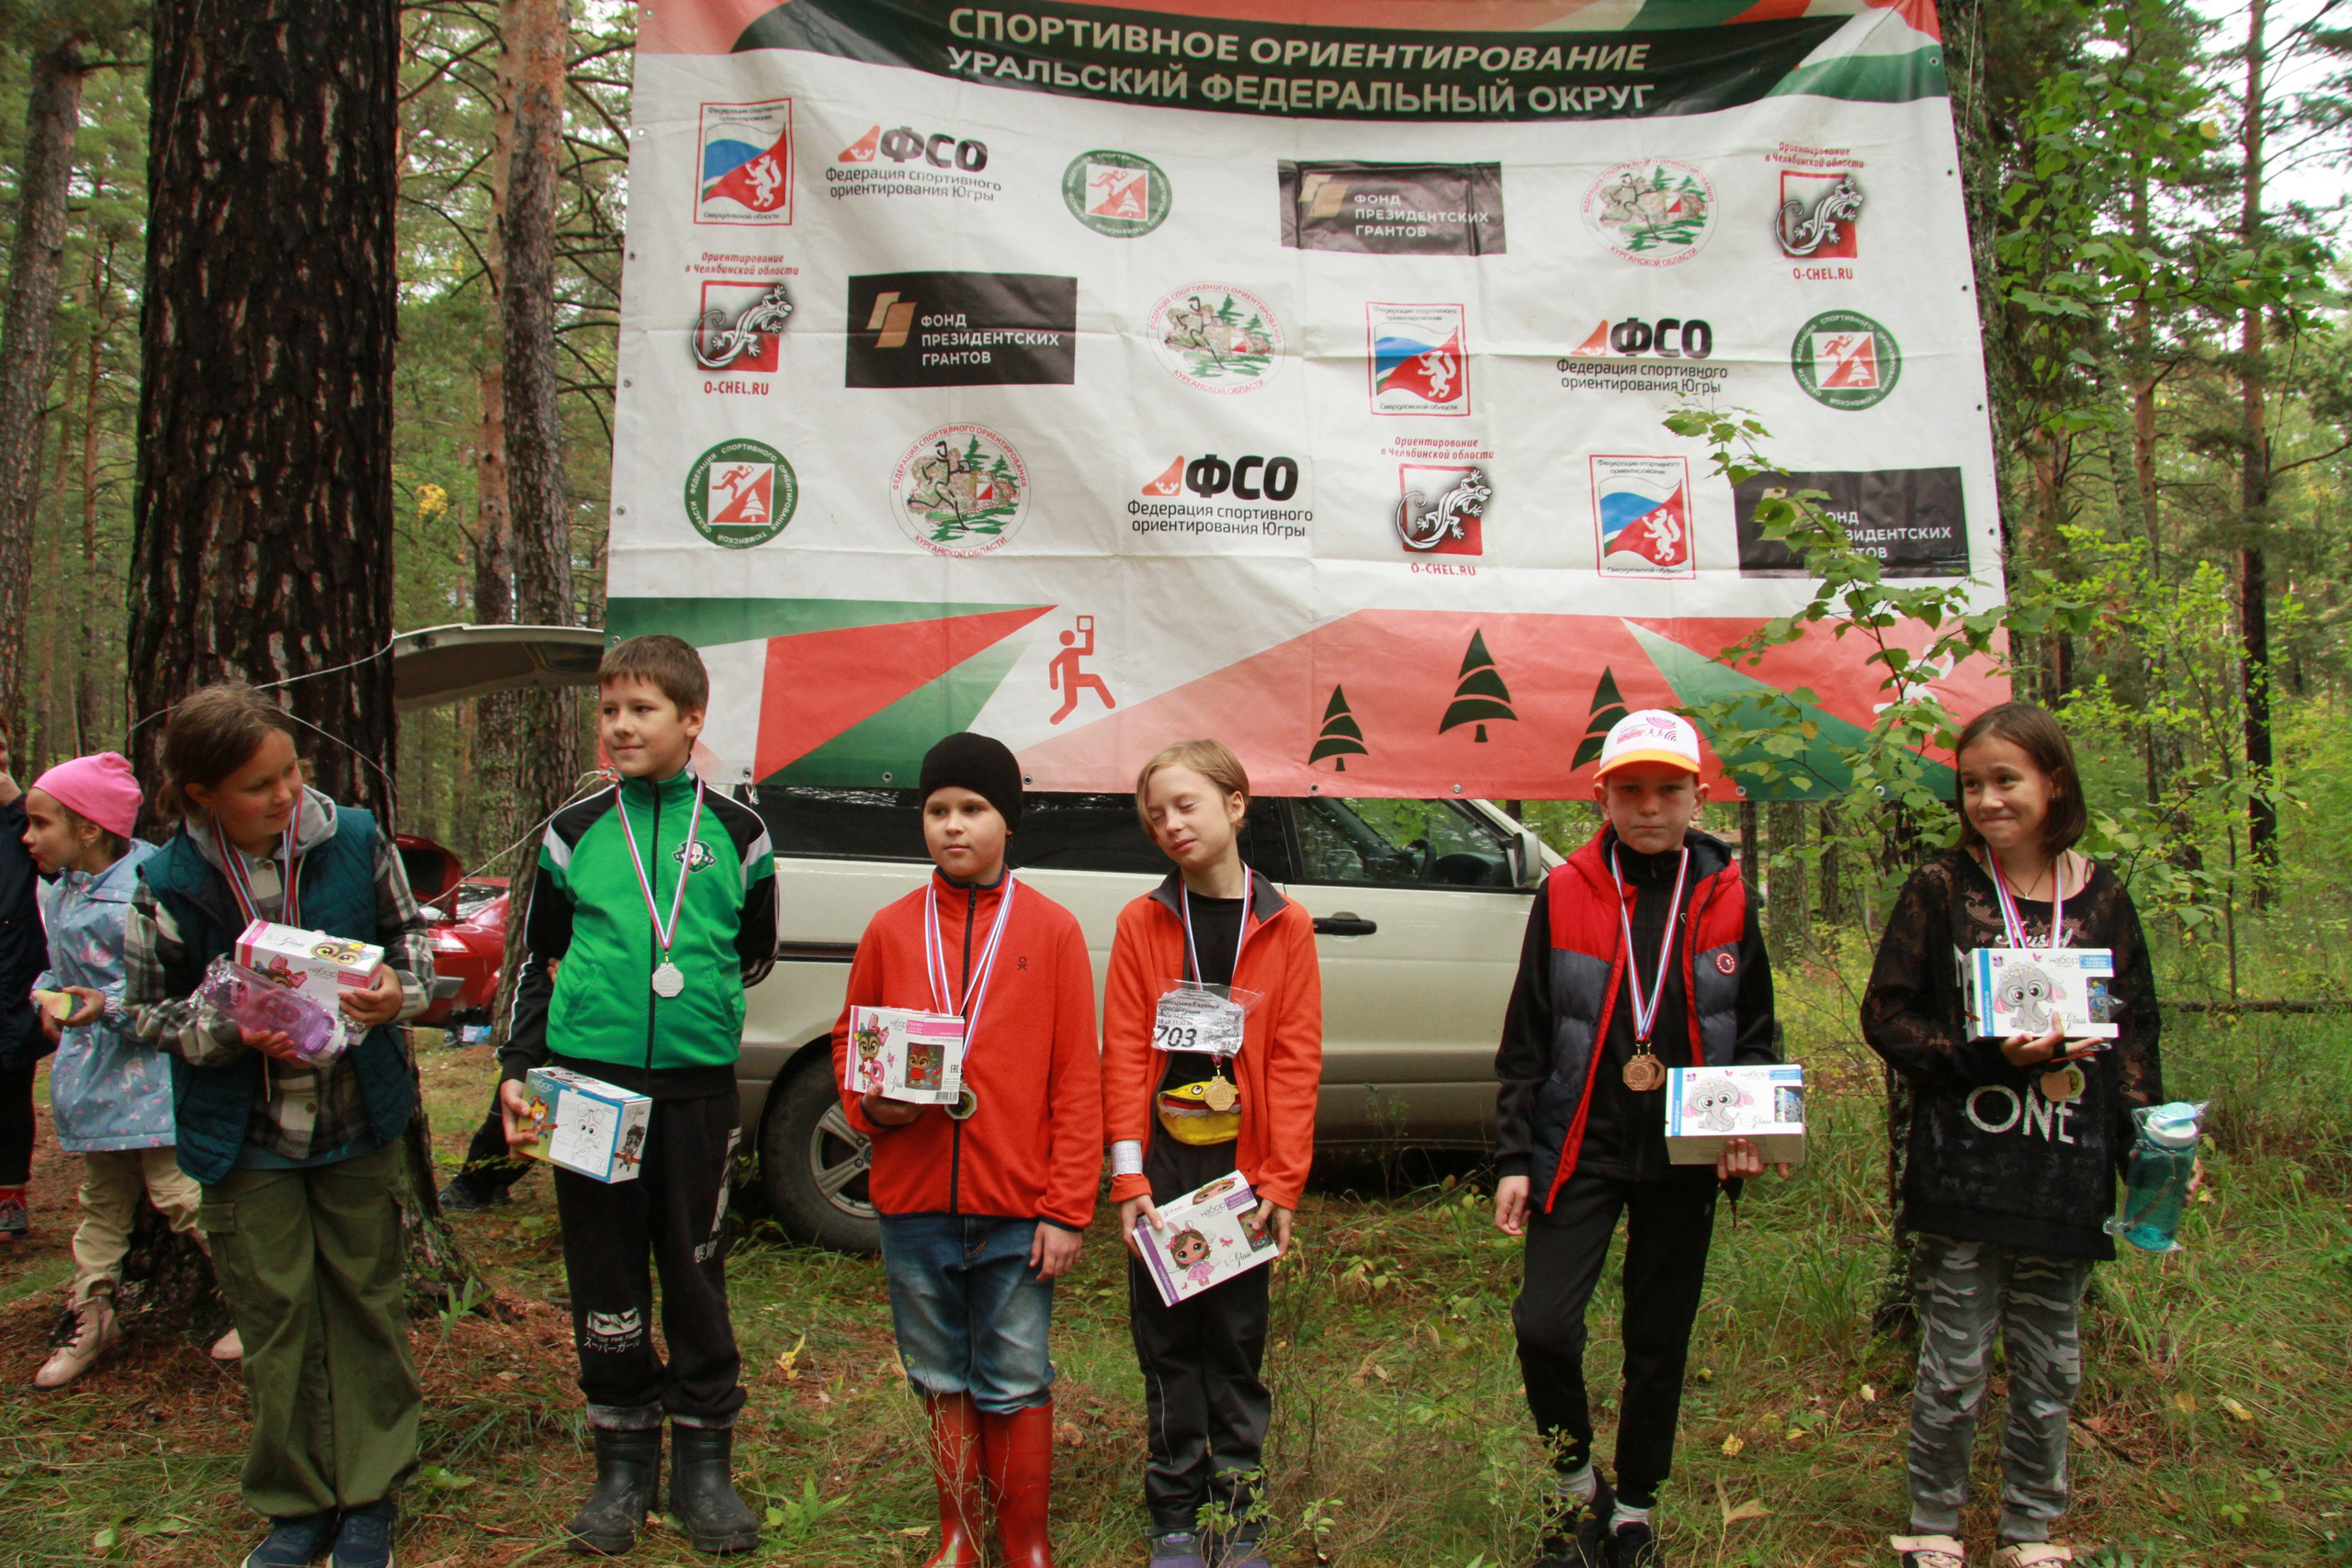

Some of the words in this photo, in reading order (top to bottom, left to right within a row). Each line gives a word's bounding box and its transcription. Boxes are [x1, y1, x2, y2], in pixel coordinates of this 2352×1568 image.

[949, 8, 1238, 62] СПОРТИВНОЕ
[1250, 38, 1651, 72] ОРИЕНТИРОВАНИЕ
[947, 46, 1188, 98] УРАЛЬСКИЙ
[1201, 73, 1515, 113] ФЕДЕРАЛЬНЫЙ
[1528, 84, 1655, 112] ОКРУГ
[879, 125, 989, 173] ФСО
[1779, 141, 1850, 157] Ориентирование
[1772, 152, 1825, 168] Челябинской
[1826, 158, 1865, 169] области
[825, 166, 905, 183] Федерация
[909, 170, 1001, 192] спортивного
[830, 183, 948, 201] ориентирования
[953, 186, 994, 202] Югры
[1354, 194, 1401, 206] ФОНД
[1355, 209, 1489, 223] ПРЕЗИДЕНТСКИХ
[1355, 225, 1427, 237] ГРАНТОВ
[702, 252, 785, 265] Ориентирование
[1610, 245, 1661, 266] КУРГАНСКОЙ
[1662, 247, 1698, 266] ОБЛАСТИ
[694, 264, 755, 276] Челябинской
[758, 266, 799, 276] области
[1793, 267, 1854, 280] O-CHEL.RU
[921, 313, 967, 328] ФОНД
[1171, 284, 1230, 300] СПОРТИВНОГО
[1231, 287, 1283, 344] ОРИЕНТИРОВАНИЯ
[1820, 314, 1874, 331] СПОРТИВНОГО
[922, 333, 1060, 347] ПРЕЗИДЕНТСКИХ
[1610, 317, 1713, 359] ФСО
[922, 351, 992, 366] ГРАНТОВ
[1556, 357, 1637, 377] Федерация
[1640, 364, 1728, 378] спортивного
[704, 380, 769, 396] O-CHEL.RU
[1173, 368, 1227, 394] КУРГАНСКОЙ
[1227, 379, 1265, 395] ОБЛАСТИ
[1561, 377, 1679, 393] ориентирования
[1681, 378, 1721, 396] Югры
[1395, 436, 1479, 449] Ориентирование
[892, 445, 920, 491] ФЕДЕРАЦИЯ
[919, 424, 976, 446] СПОРТИВНОГО
[977, 427, 1027, 488] ОРИЕНТИРОВАНИЯ
[1388, 447, 1450, 459] Челябинской
[1453, 449, 1495, 459] области
[1186, 454, 1299, 502] ФСО
[689, 453, 718, 494] ФЕДЕРАЦИЯ
[721, 443, 777, 461] СПОРТИВНОГО
[770, 464, 793, 531] ОРИЕНТИРОВАНИЯ
[690, 501, 712, 533] ОБЛАСТИ
[1127, 499, 1214, 518] Федерация
[1217, 506, 1313, 523] спортивного
[1821, 512, 1860, 525] ОНД
[1132, 519, 1258, 536] ориентирования
[1262, 522, 1306, 540] Югры
[1814, 526, 1952, 543] ЗИДЕНТСКИХ
[718, 532, 767, 545] ТЮМЕНСКОЙ
[914, 535, 967, 558] КУРГАНСКОЙ
[968, 536, 1008, 558] ОБЛАСТИ
[1410, 562, 1477, 577] O-CHEL.RU
[2049, 954, 2078, 964] набор
[309, 965, 338, 979] набор
[1157, 1024, 1197, 1048] 703
[1739, 1069, 1768, 1079] набор
[530, 1077, 554, 1092] набор
[1965, 1084, 2083, 1145] ONE
[1200, 1201, 1227, 1218] набор
[1229, 1250, 1252, 1271] Glass
